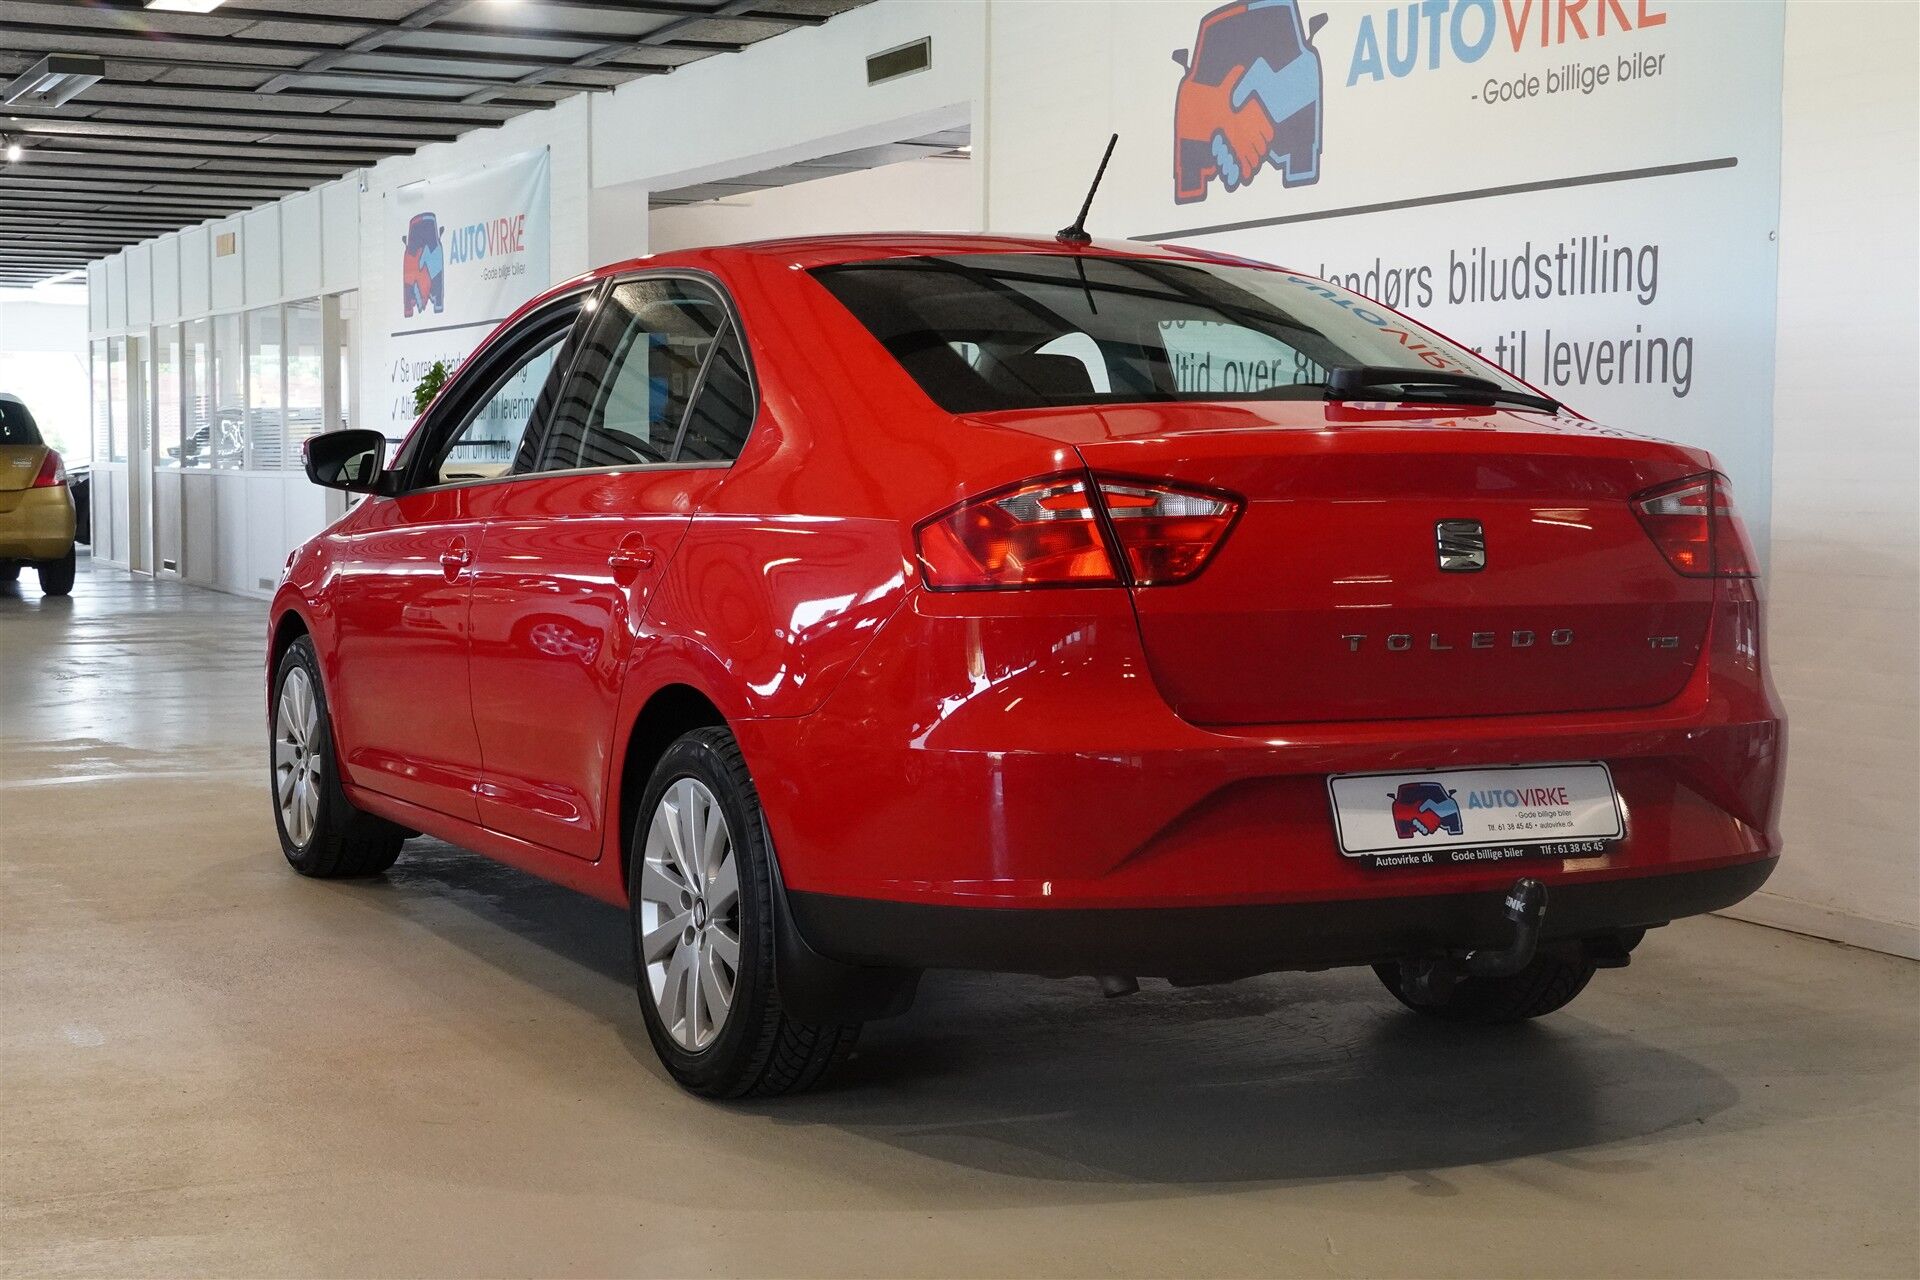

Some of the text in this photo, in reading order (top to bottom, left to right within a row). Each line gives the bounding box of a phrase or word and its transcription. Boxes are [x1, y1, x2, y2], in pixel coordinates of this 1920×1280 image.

[1482, 73, 1540, 105] Gode
[1546, 62, 1611, 95] billige
[1616, 51, 1667, 83] biler
[449, 213, 526, 265] AUTOVIRKE
[1448, 234, 1660, 305] biludstilling
[400, 357, 410, 383] Se
[1223, 357, 1282, 393] over
[1543, 324, 1694, 398] levering
[1341, 628, 1575, 651] TOLEDO
[1468, 787, 1570, 810] AUTOVIRKE
[1498, 823, 1506, 831] 61
[1516, 822, 1524, 830] 45
[1518, 811, 1537, 819] Gode
[1375, 854, 1420, 867] Autovirke
[1421, 852, 1434, 863] dk
[1451, 851, 1476, 861] Gode
[1477, 849, 1503, 861] billige
[1503, 847, 1524, 857] biler
[1557, 843, 1569, 853] 61
[1570, 842, 1581, 852] 38
[1581, 842, 1592, 852] 45
[1593, 841, 1604, 851] 45
